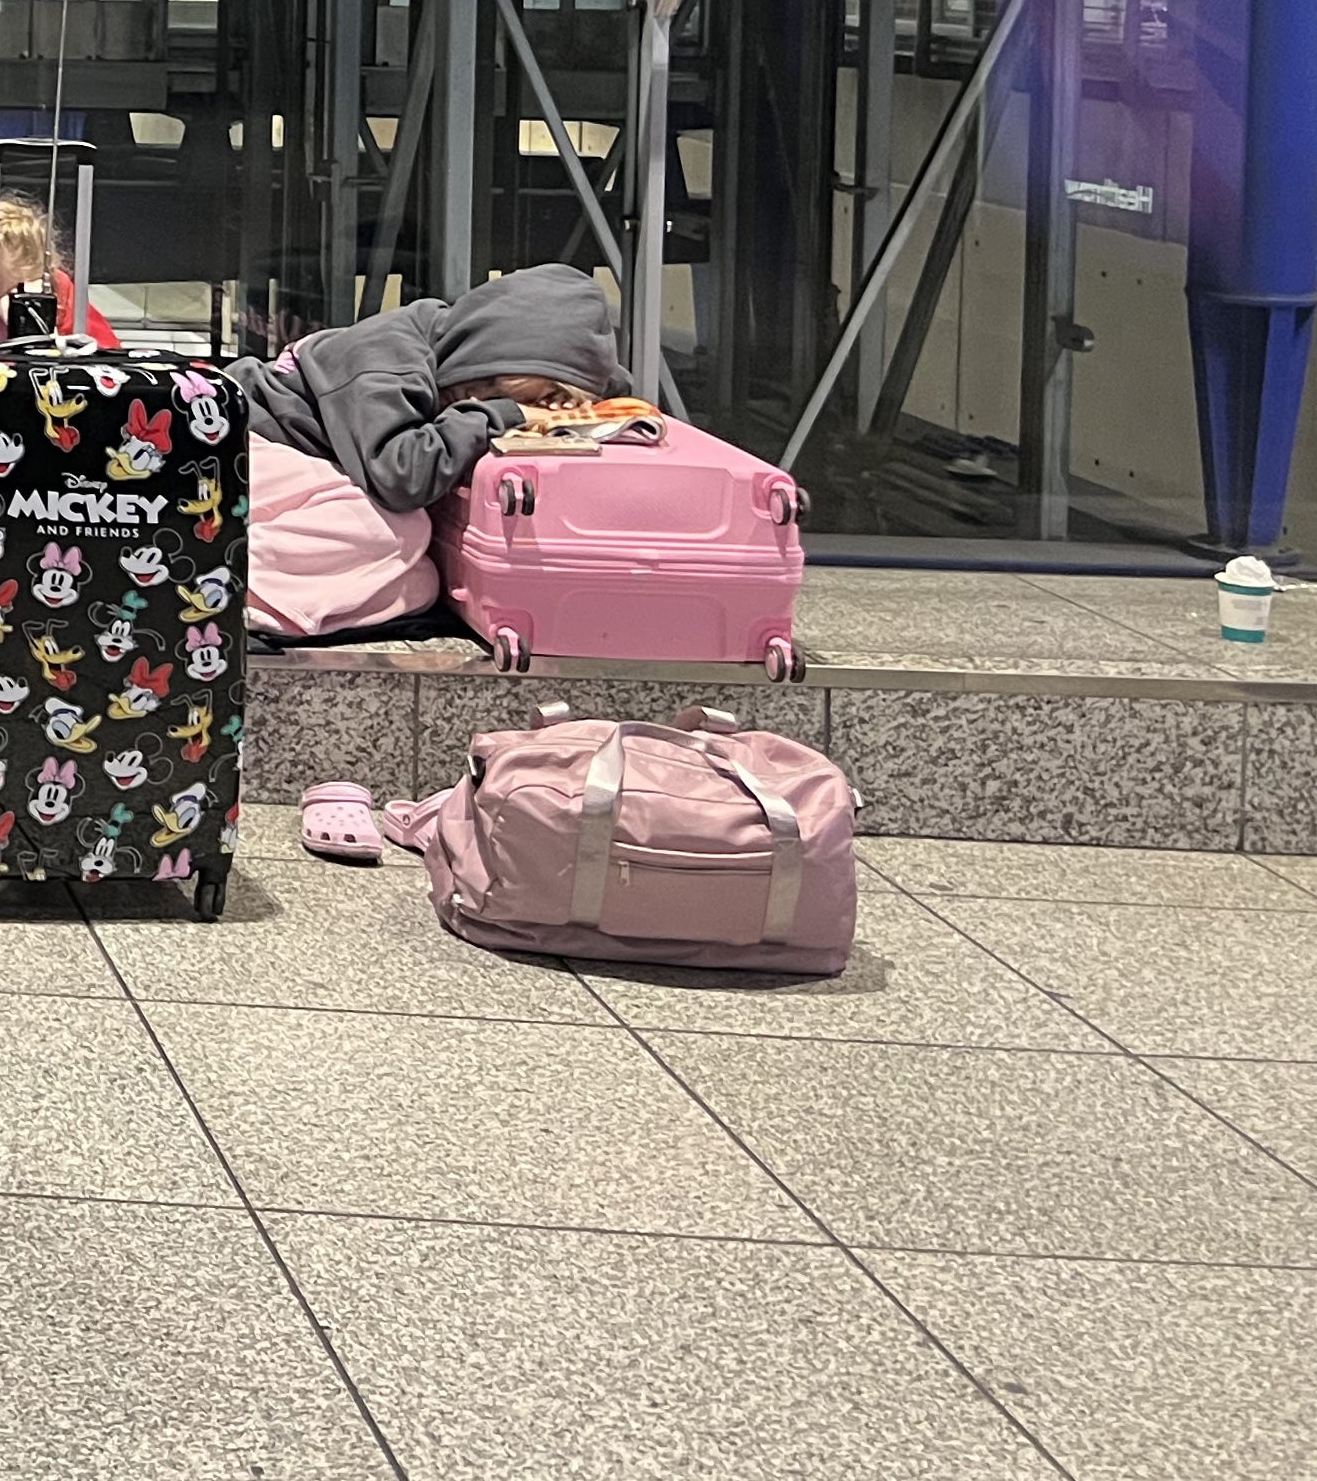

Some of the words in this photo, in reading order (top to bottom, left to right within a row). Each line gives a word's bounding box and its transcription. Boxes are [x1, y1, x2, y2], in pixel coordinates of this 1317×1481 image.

[61, 472, 108, 494] Disney
[6, 488, 169, 524] MICKEY
[36, 525, 69, 536] AND
[75, 526, 140, 539] FRIENDS
